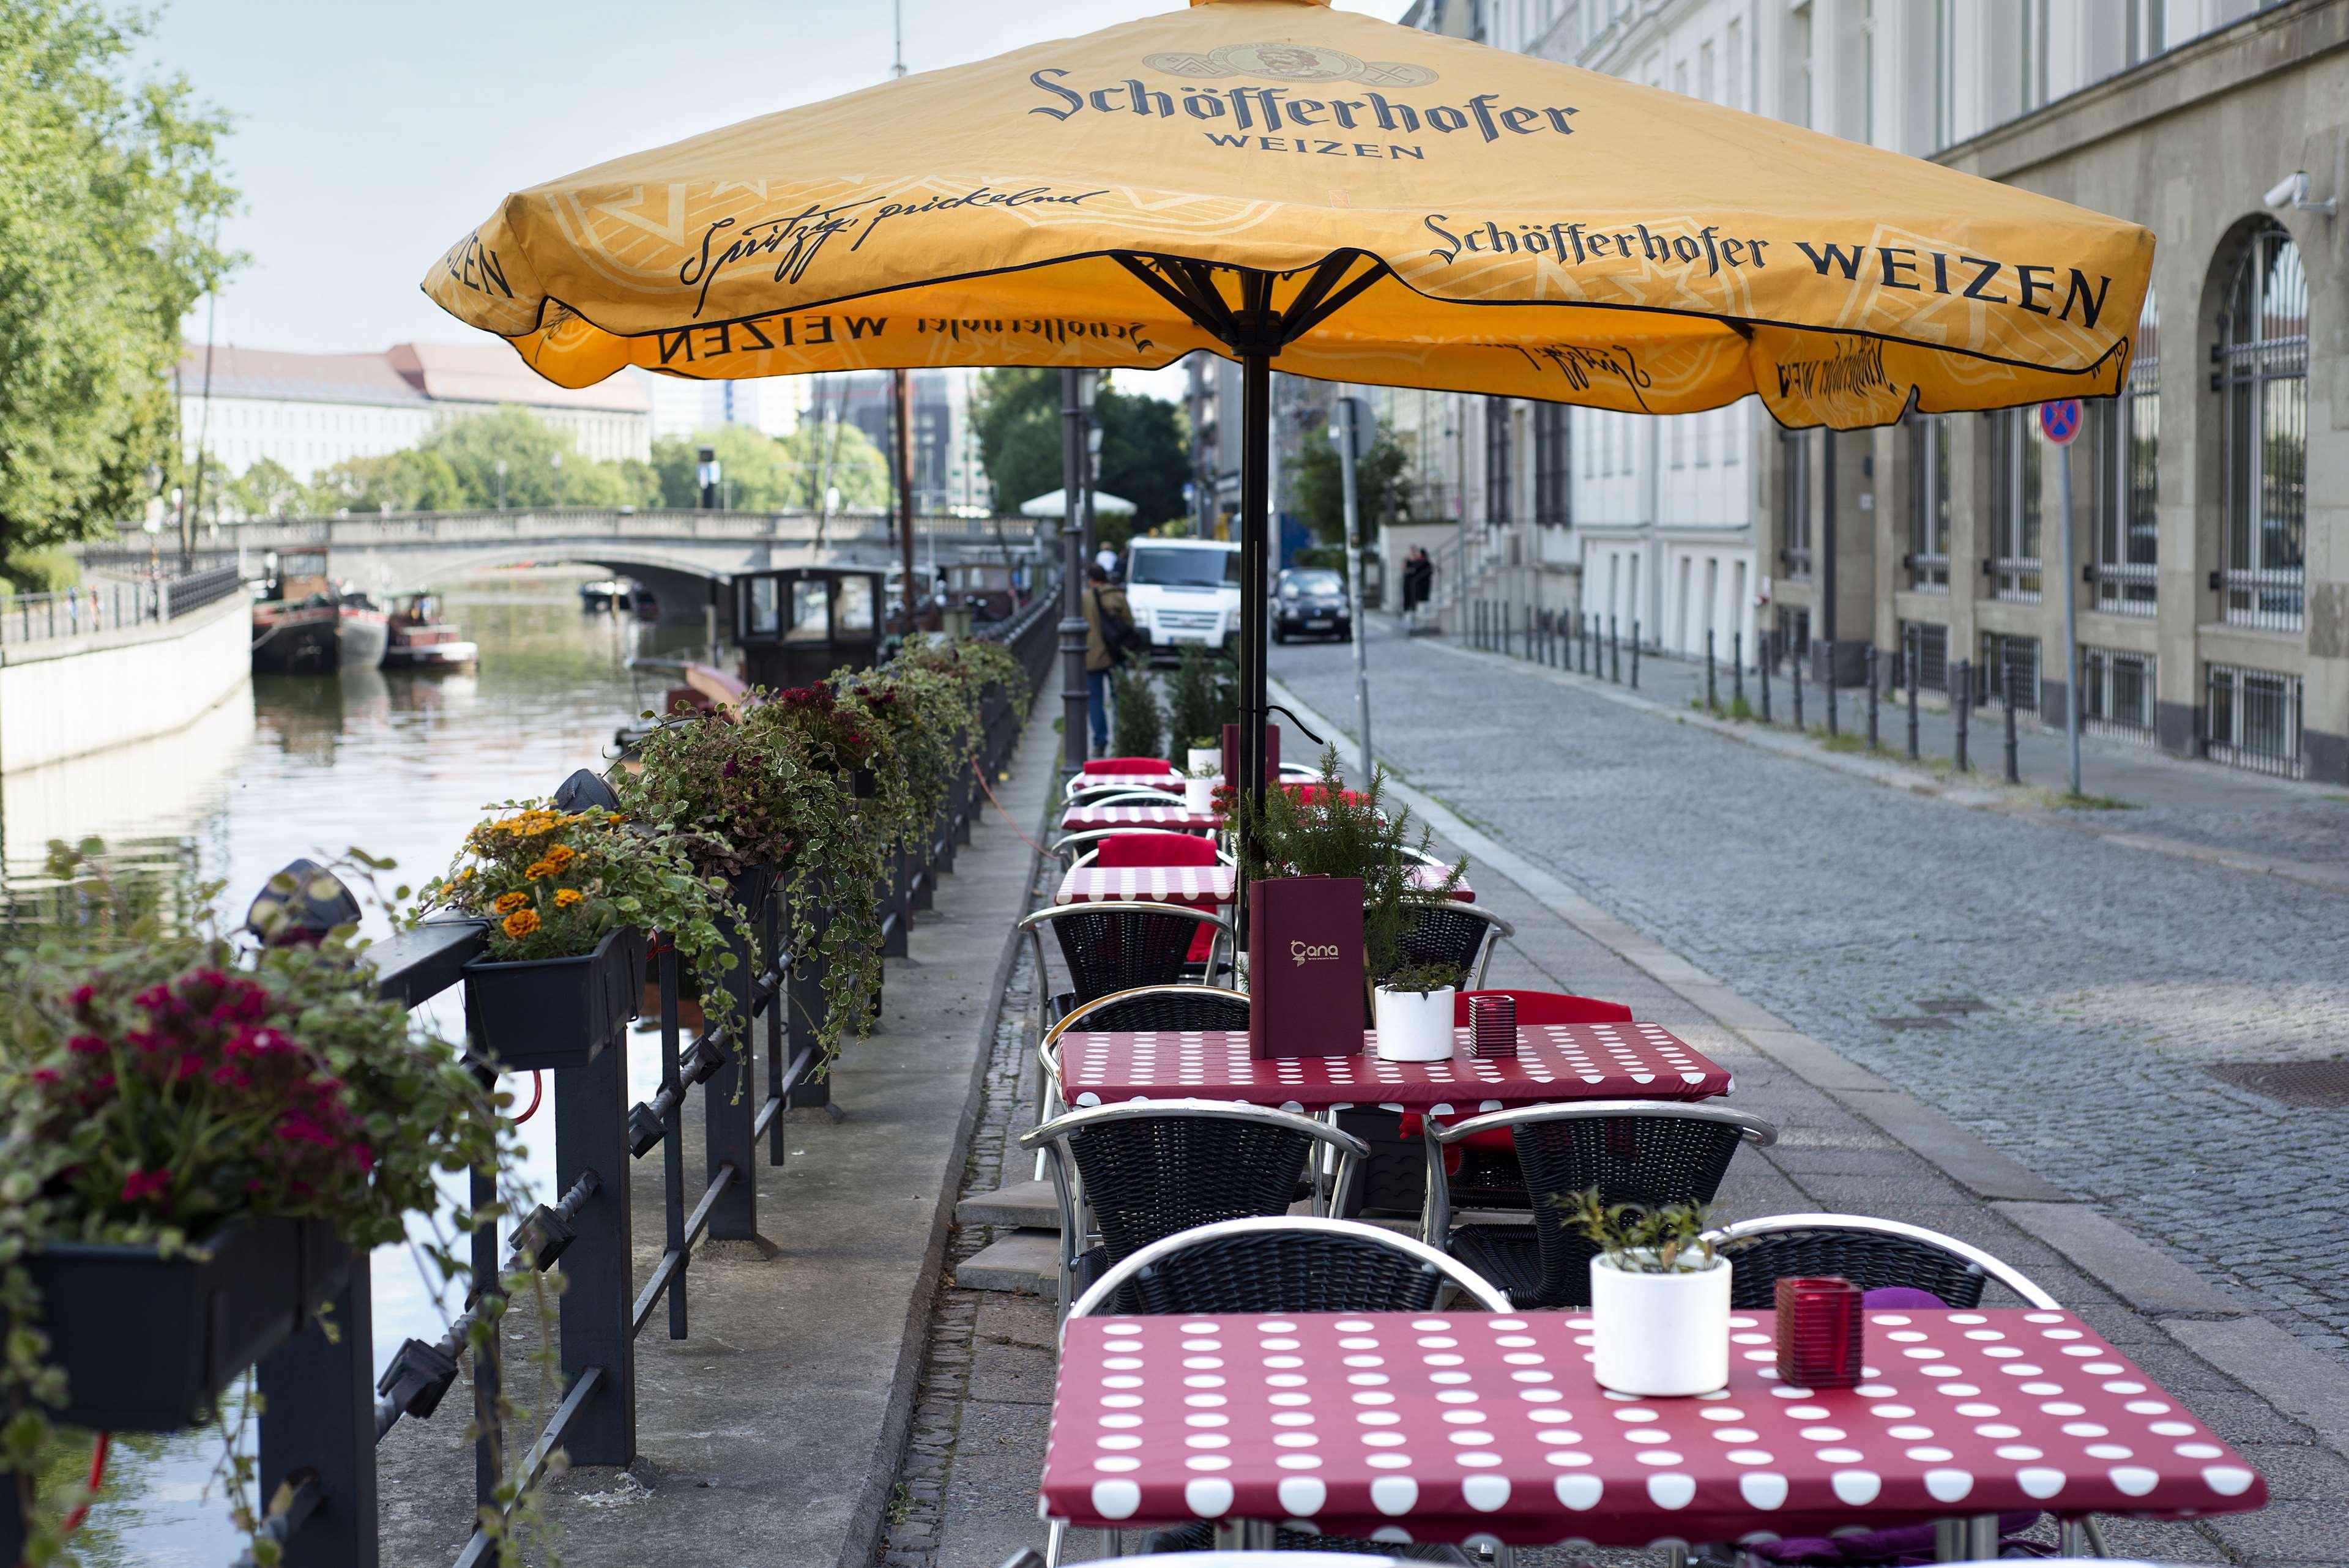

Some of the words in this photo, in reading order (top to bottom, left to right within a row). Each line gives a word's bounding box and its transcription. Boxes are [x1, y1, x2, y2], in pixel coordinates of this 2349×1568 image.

[1028, 68, 1580, 144] Schöfferhofer
[1204, 132, 1424, 160] WEIZEN
[850, 187, 1110, 252] prickelnd
[1424, 214, 1770, 278] Schöfferhofer
[1794, 242, 2113, 330] WEIZEN
